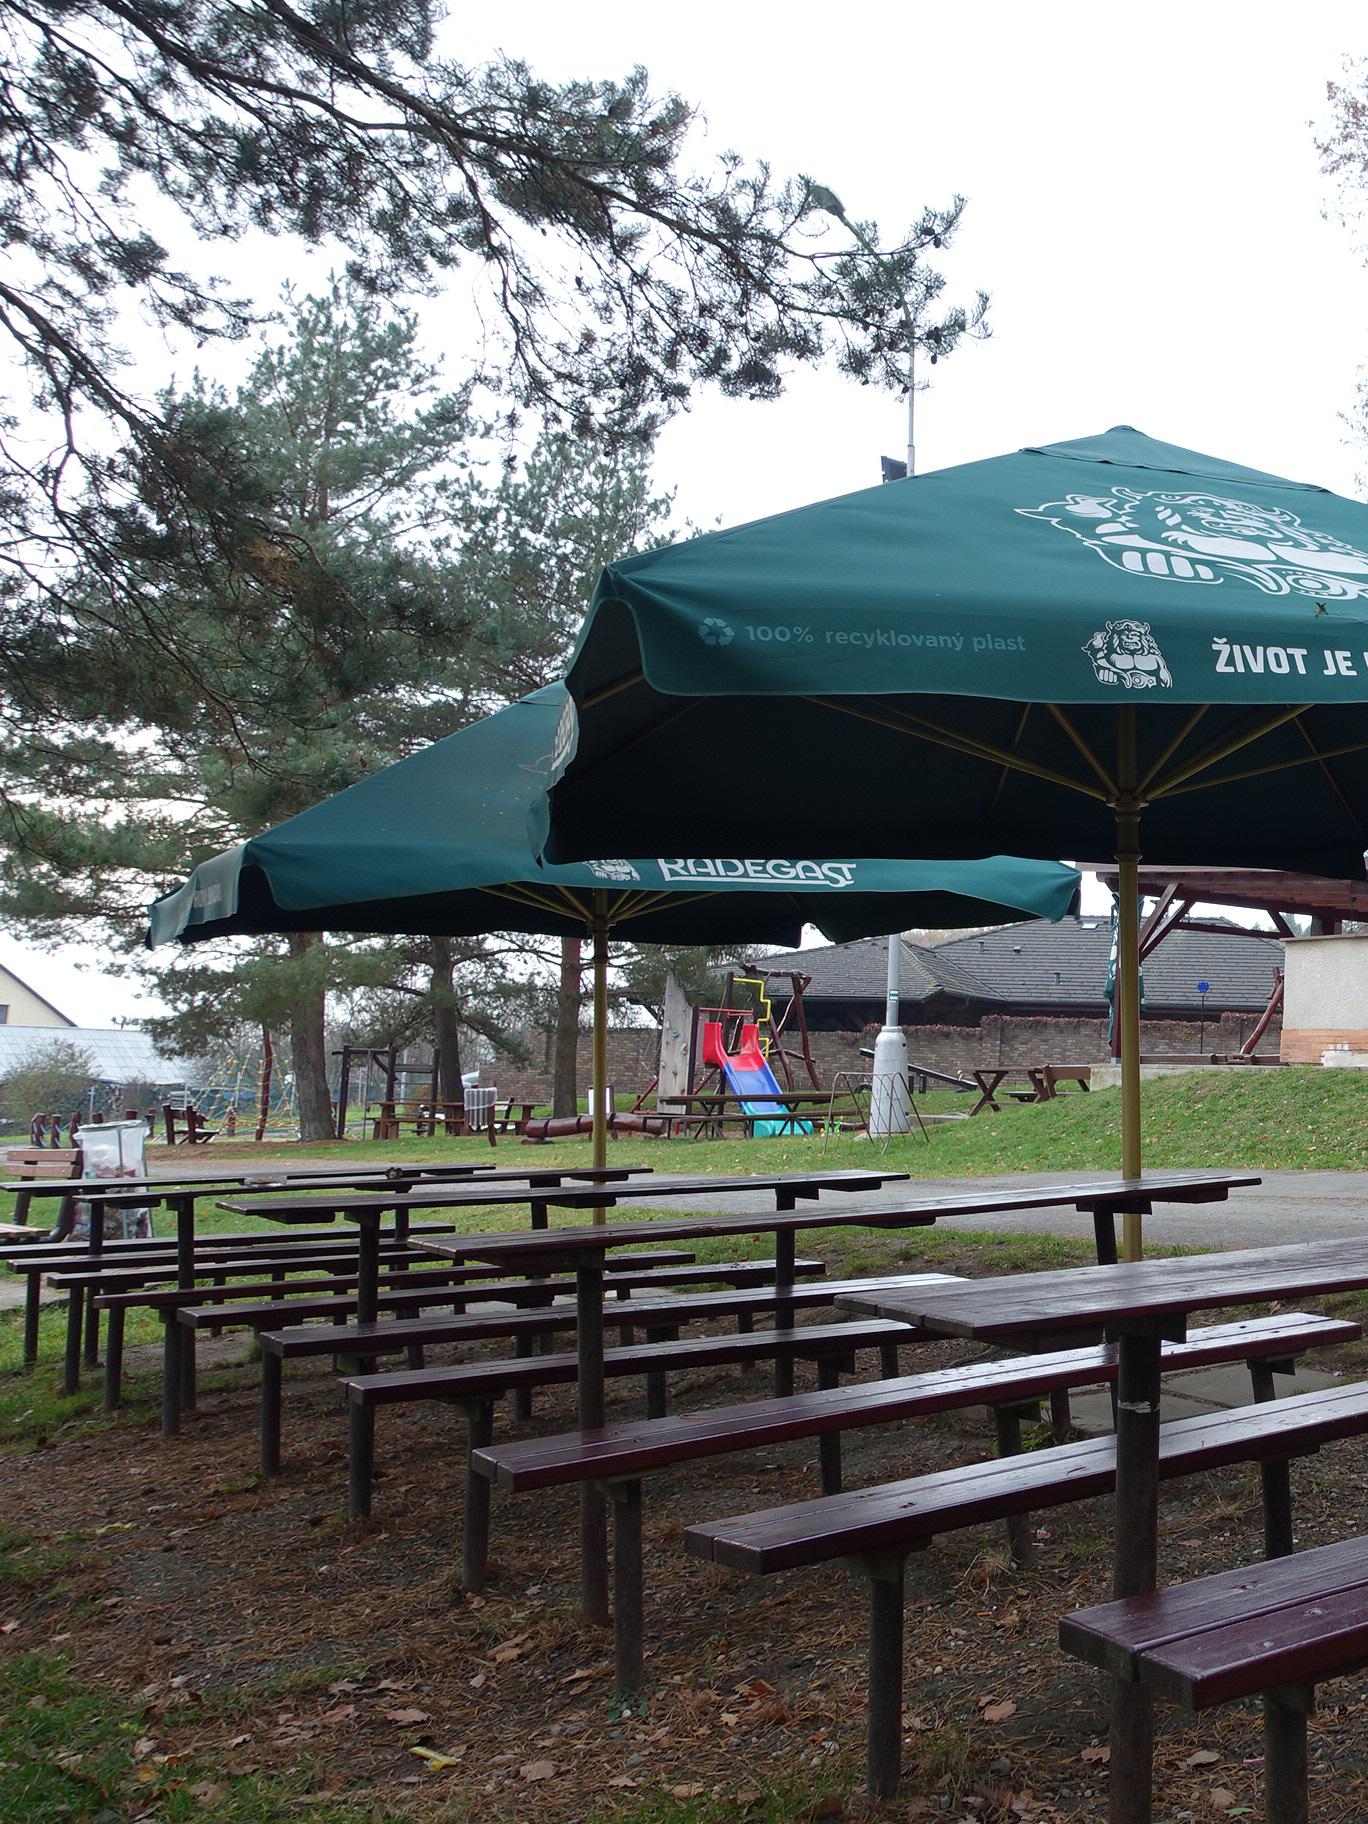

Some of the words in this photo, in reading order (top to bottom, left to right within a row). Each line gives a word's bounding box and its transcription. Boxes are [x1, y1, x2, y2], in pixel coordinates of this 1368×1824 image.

[745, 626, 814, 643] 100%
[825, 629, 965, 651] recyklovaný
[972, 633, 1027, 652] plast
[1211, 637, 1308, 675] ŽIVOT
[1323, 650, 1358, 676] JE
[657, 858, 857, 888] RADEGAST
